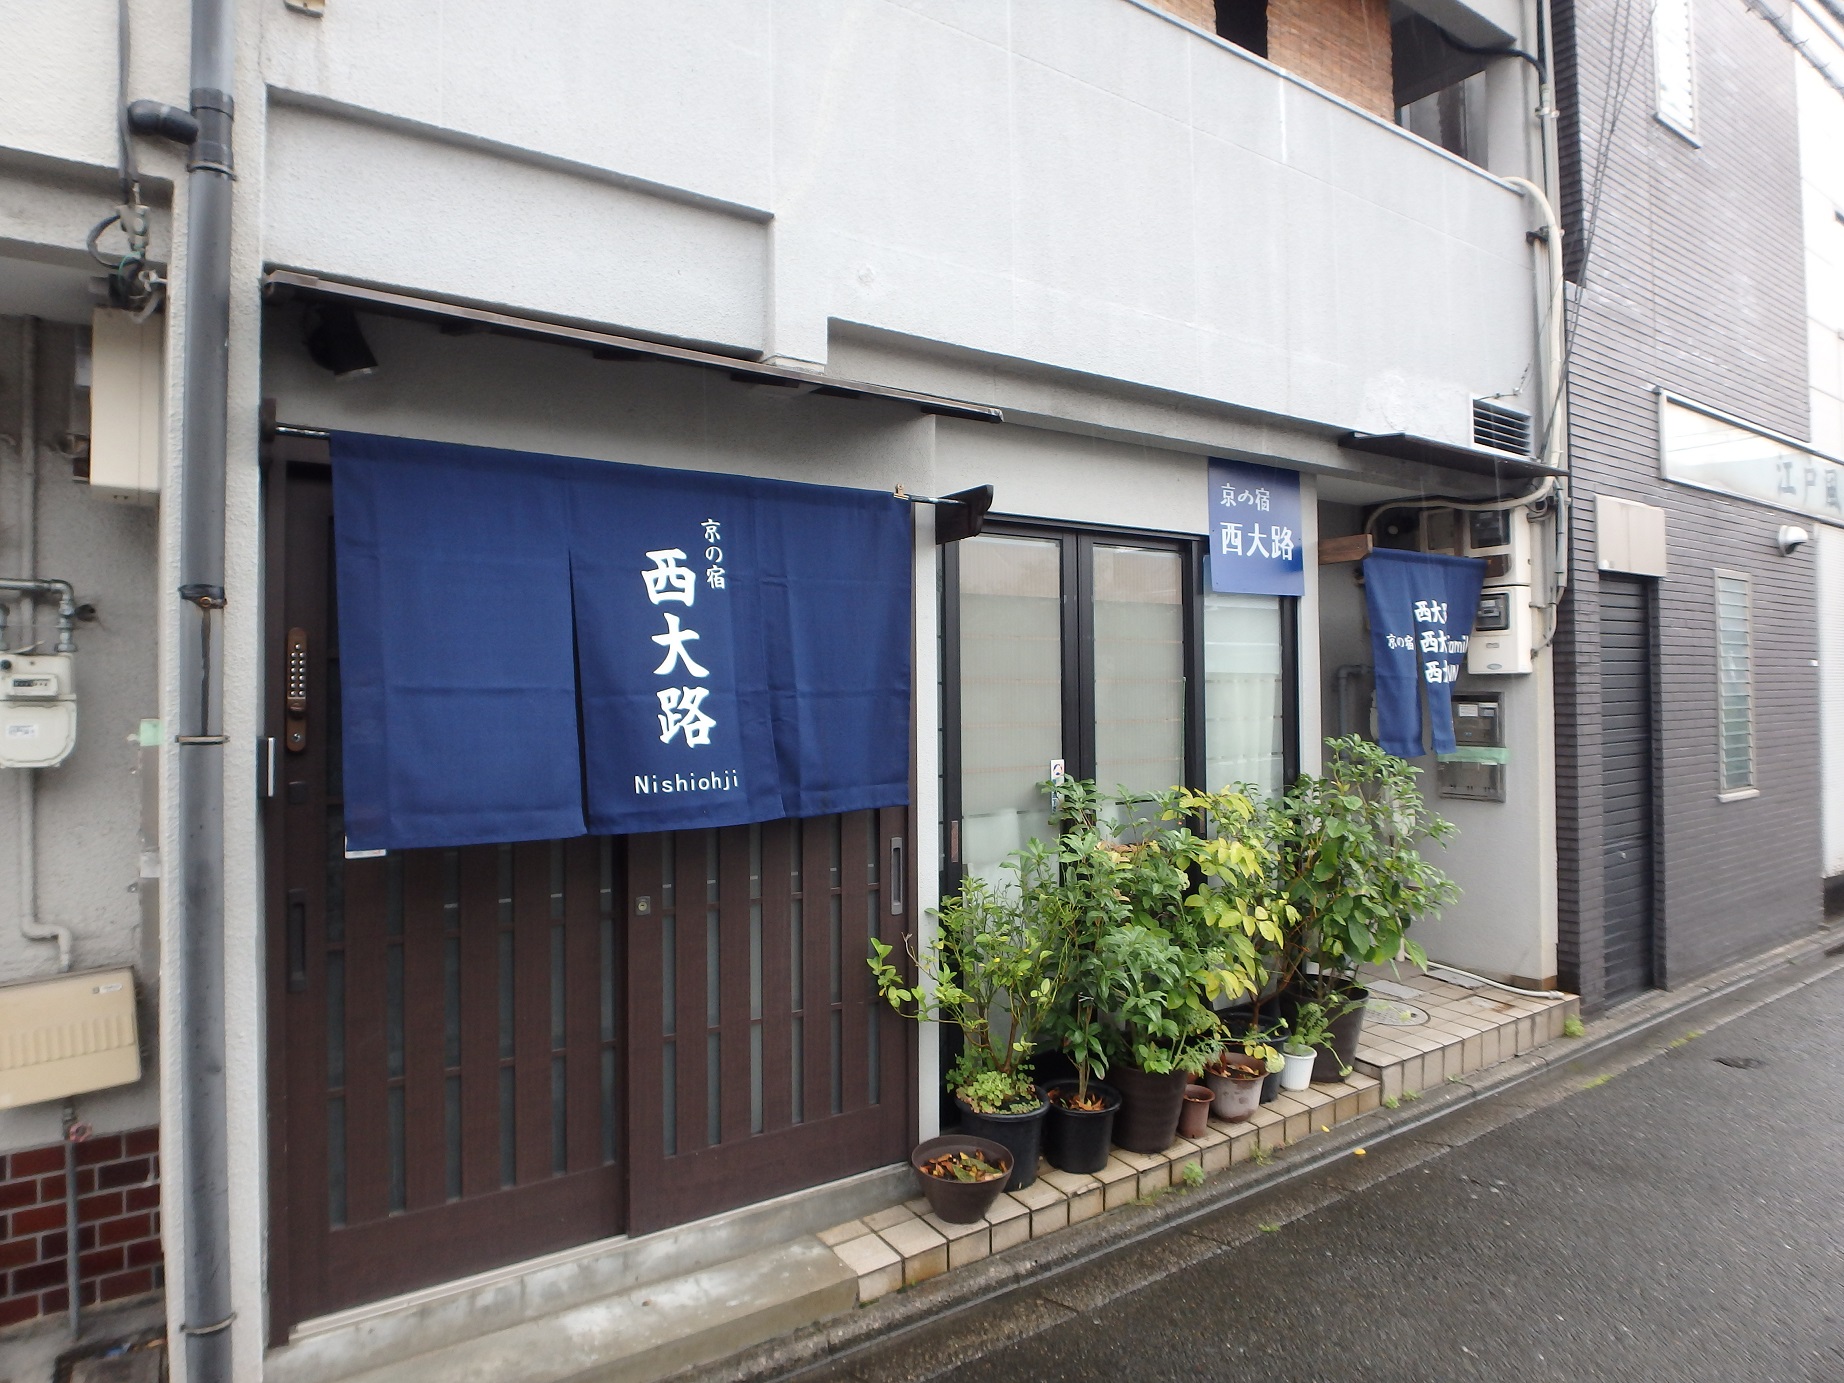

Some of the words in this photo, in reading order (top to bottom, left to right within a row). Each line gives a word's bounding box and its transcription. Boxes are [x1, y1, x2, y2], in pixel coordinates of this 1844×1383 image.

[1220, 482, 1270, 512] 京の宿
[701, 517, 726, 590] 京の宿
[1220, 521, 1295, 561] 西大路
[640, 547, 717, 749] 西大路
[1386, 633, 1415, 651] 京の宿
[634, 769, 739, 796] Nishiohji
